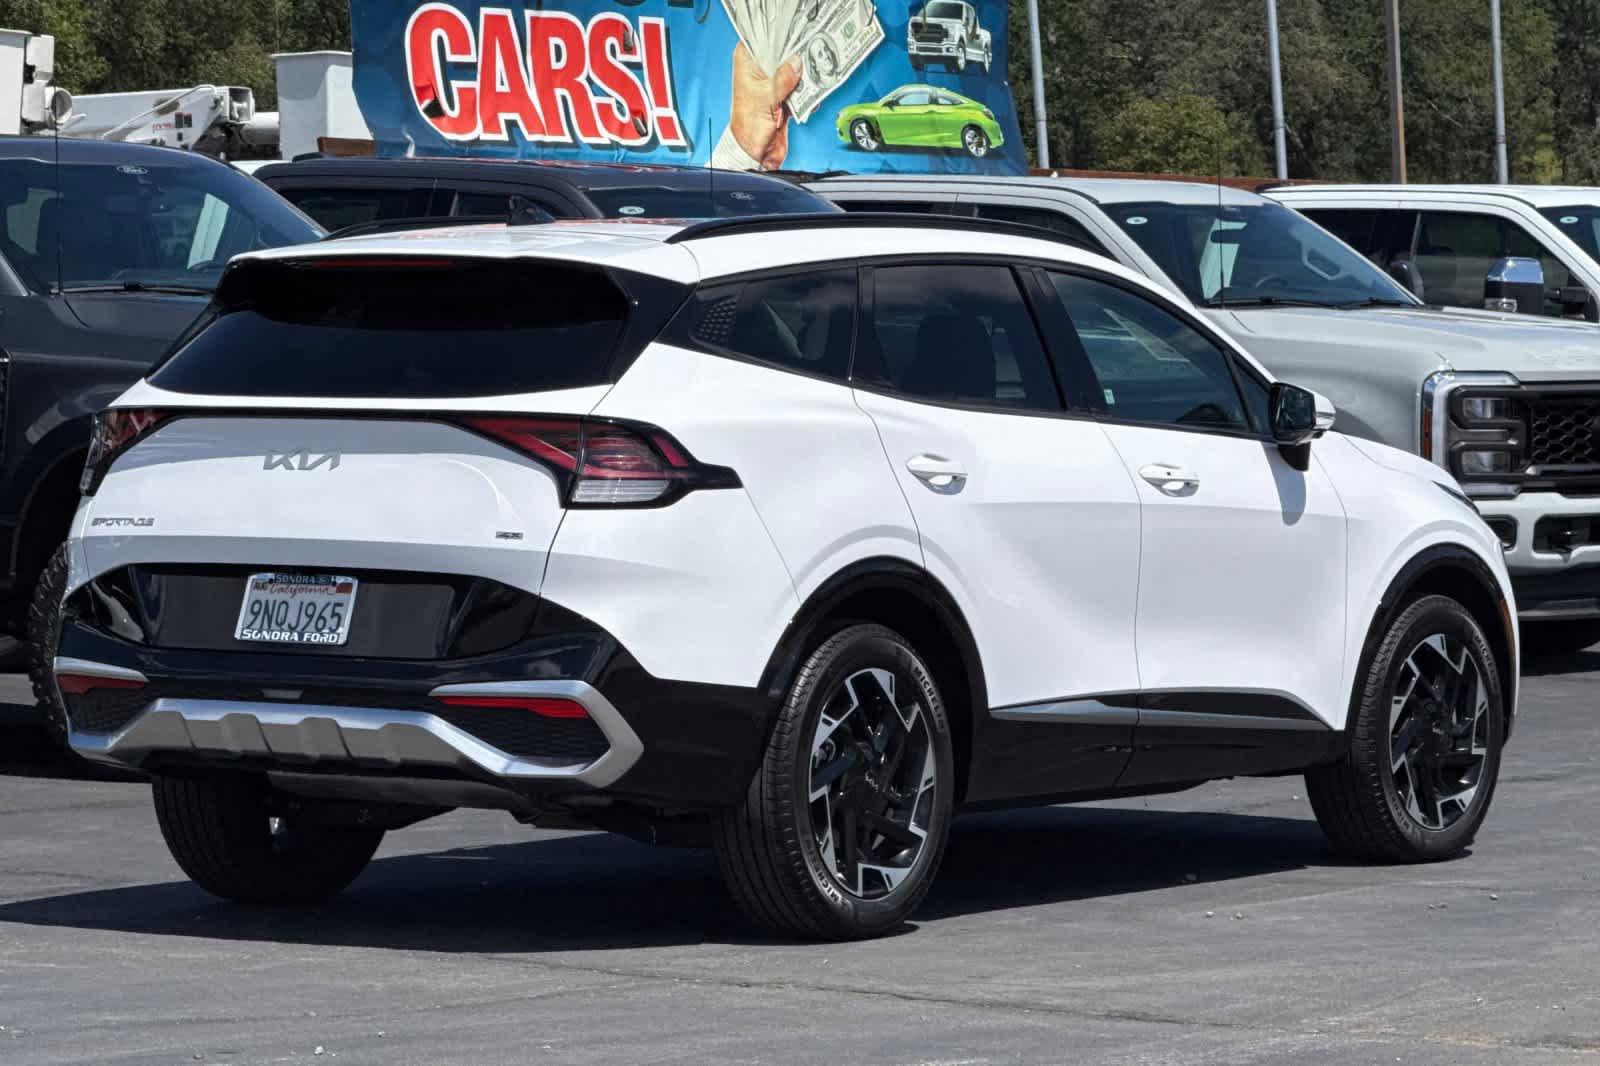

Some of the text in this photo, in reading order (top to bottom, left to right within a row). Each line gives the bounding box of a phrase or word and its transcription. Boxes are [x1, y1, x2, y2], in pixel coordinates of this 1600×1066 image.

[404, 2, 687, 146] CARS!
[263, 450, 341, 471] KIA
[91, 518, 154, 527] SPORTAGE
[269, 583, 329, 598] California
[247, 599, 344, 632] 9NQJ965
[241, 629, 338, 643] SONORA FORD
